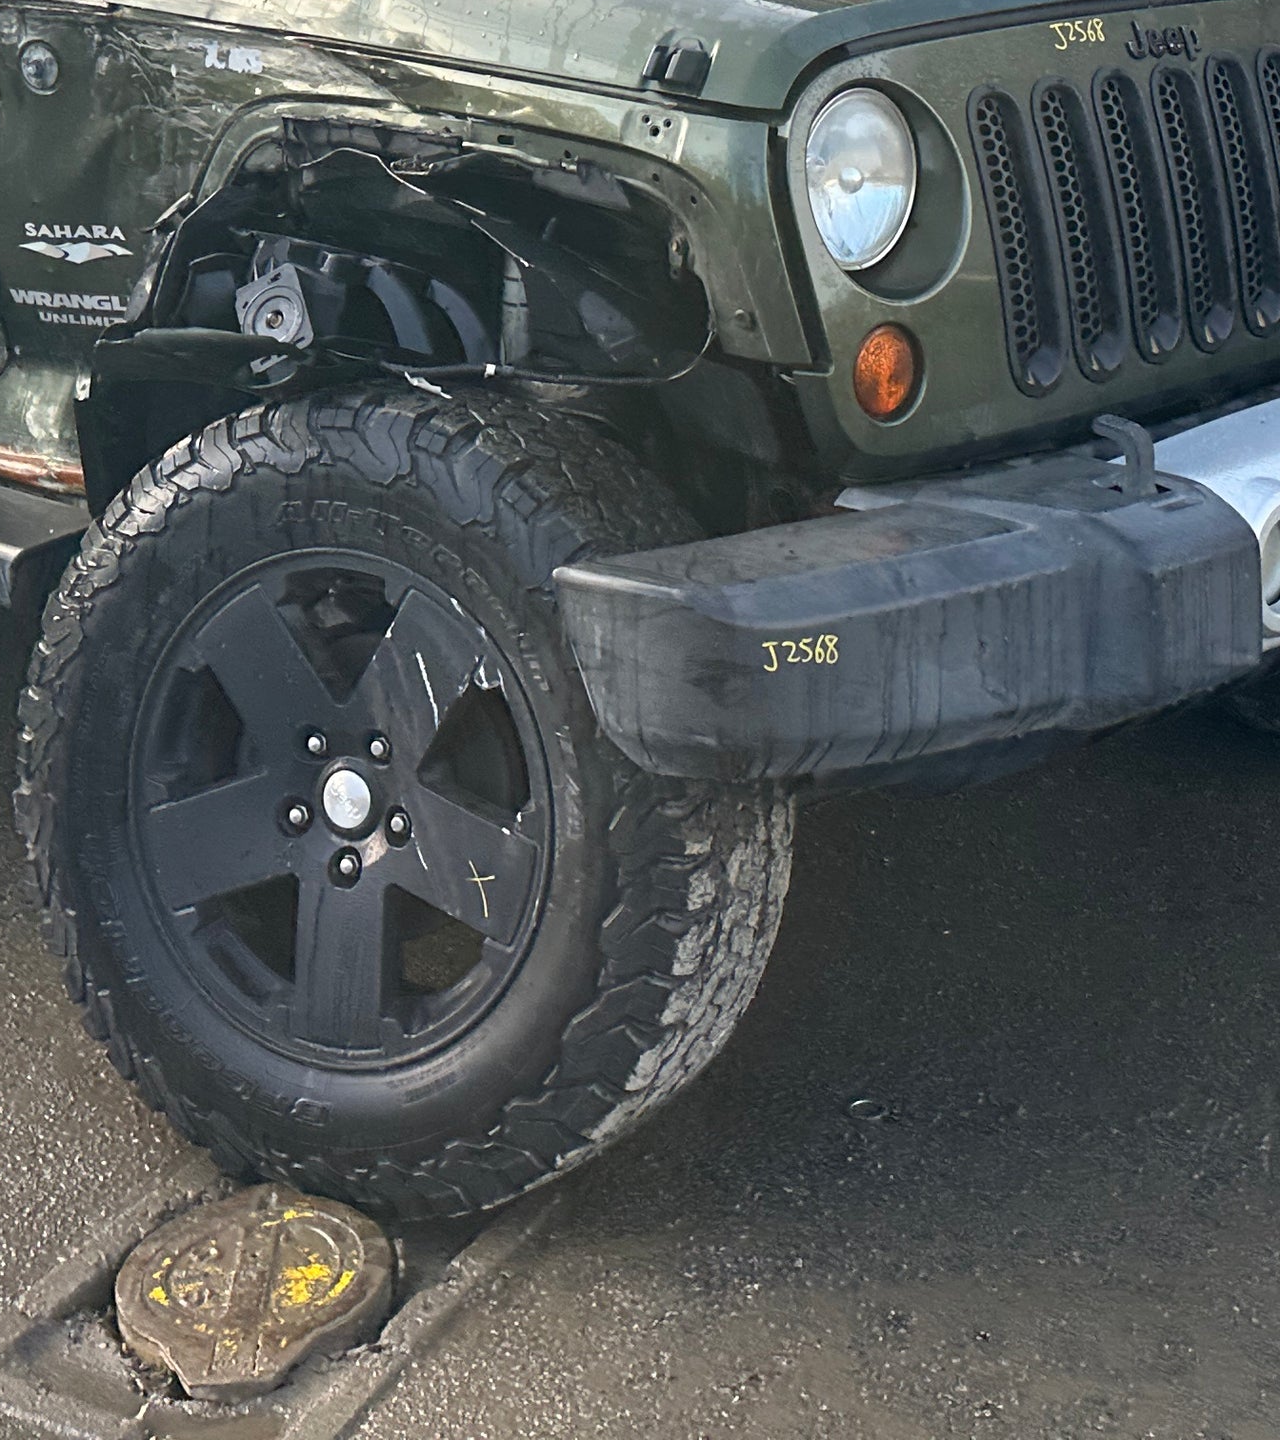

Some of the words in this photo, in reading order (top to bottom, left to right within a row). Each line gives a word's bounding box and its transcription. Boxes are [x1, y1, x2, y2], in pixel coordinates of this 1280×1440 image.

[1049, 18, 1106, 50] J2568
[1125, 19, 1202, 62] Jeep
[24, 222, 127, 242] SAHARA
[9, 288, 130, 311] WRANGL
[762, 634, 839, 672] J2568
